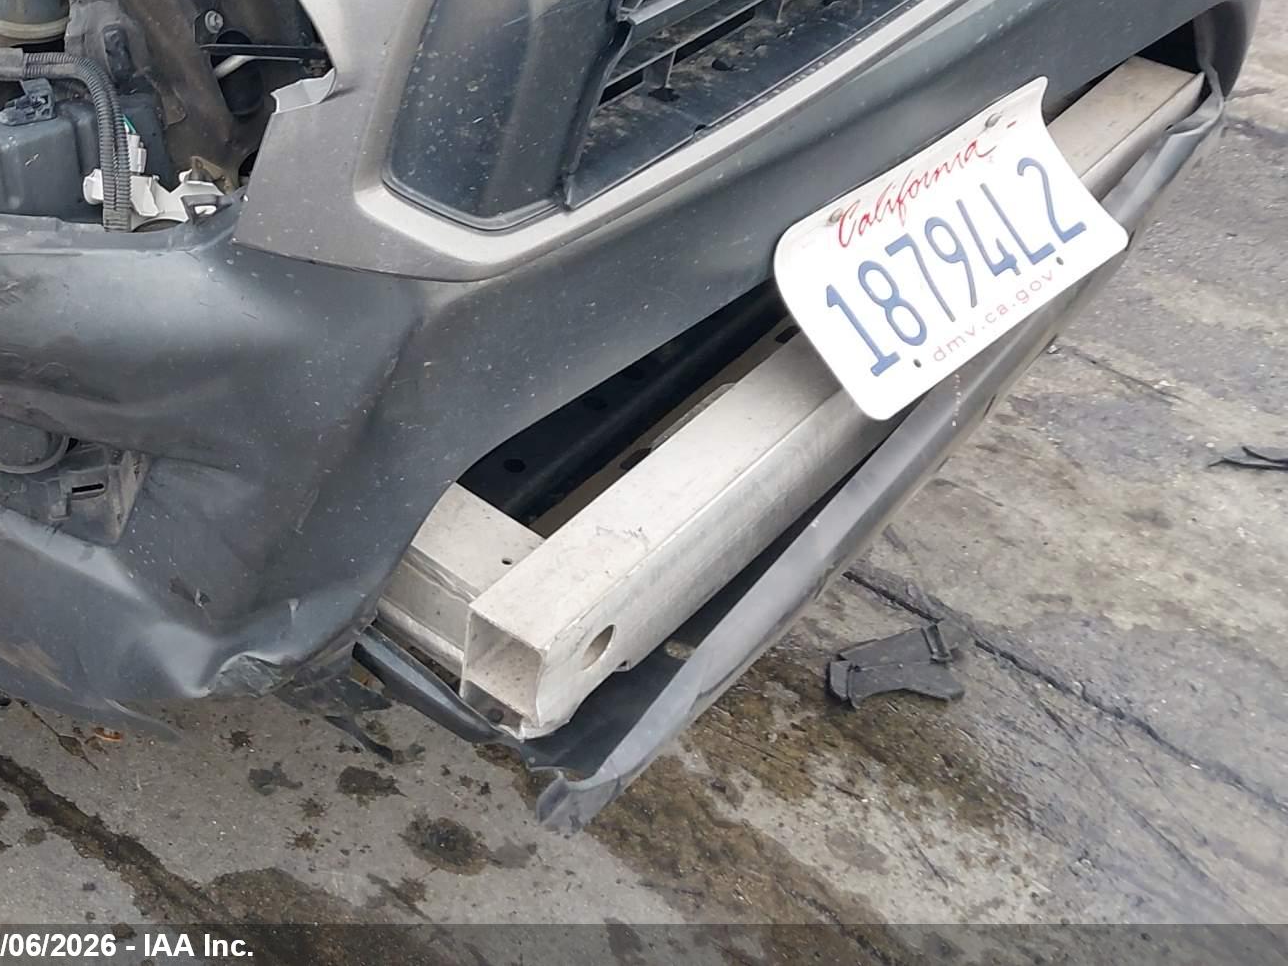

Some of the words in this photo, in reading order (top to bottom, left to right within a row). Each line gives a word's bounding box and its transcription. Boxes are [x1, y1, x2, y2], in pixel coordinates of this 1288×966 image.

[837, 139, 997, 248] California
[825, 156, 1088, 377] 18794L2
[932, 269, 1054, 363] dmv.ca.gov
